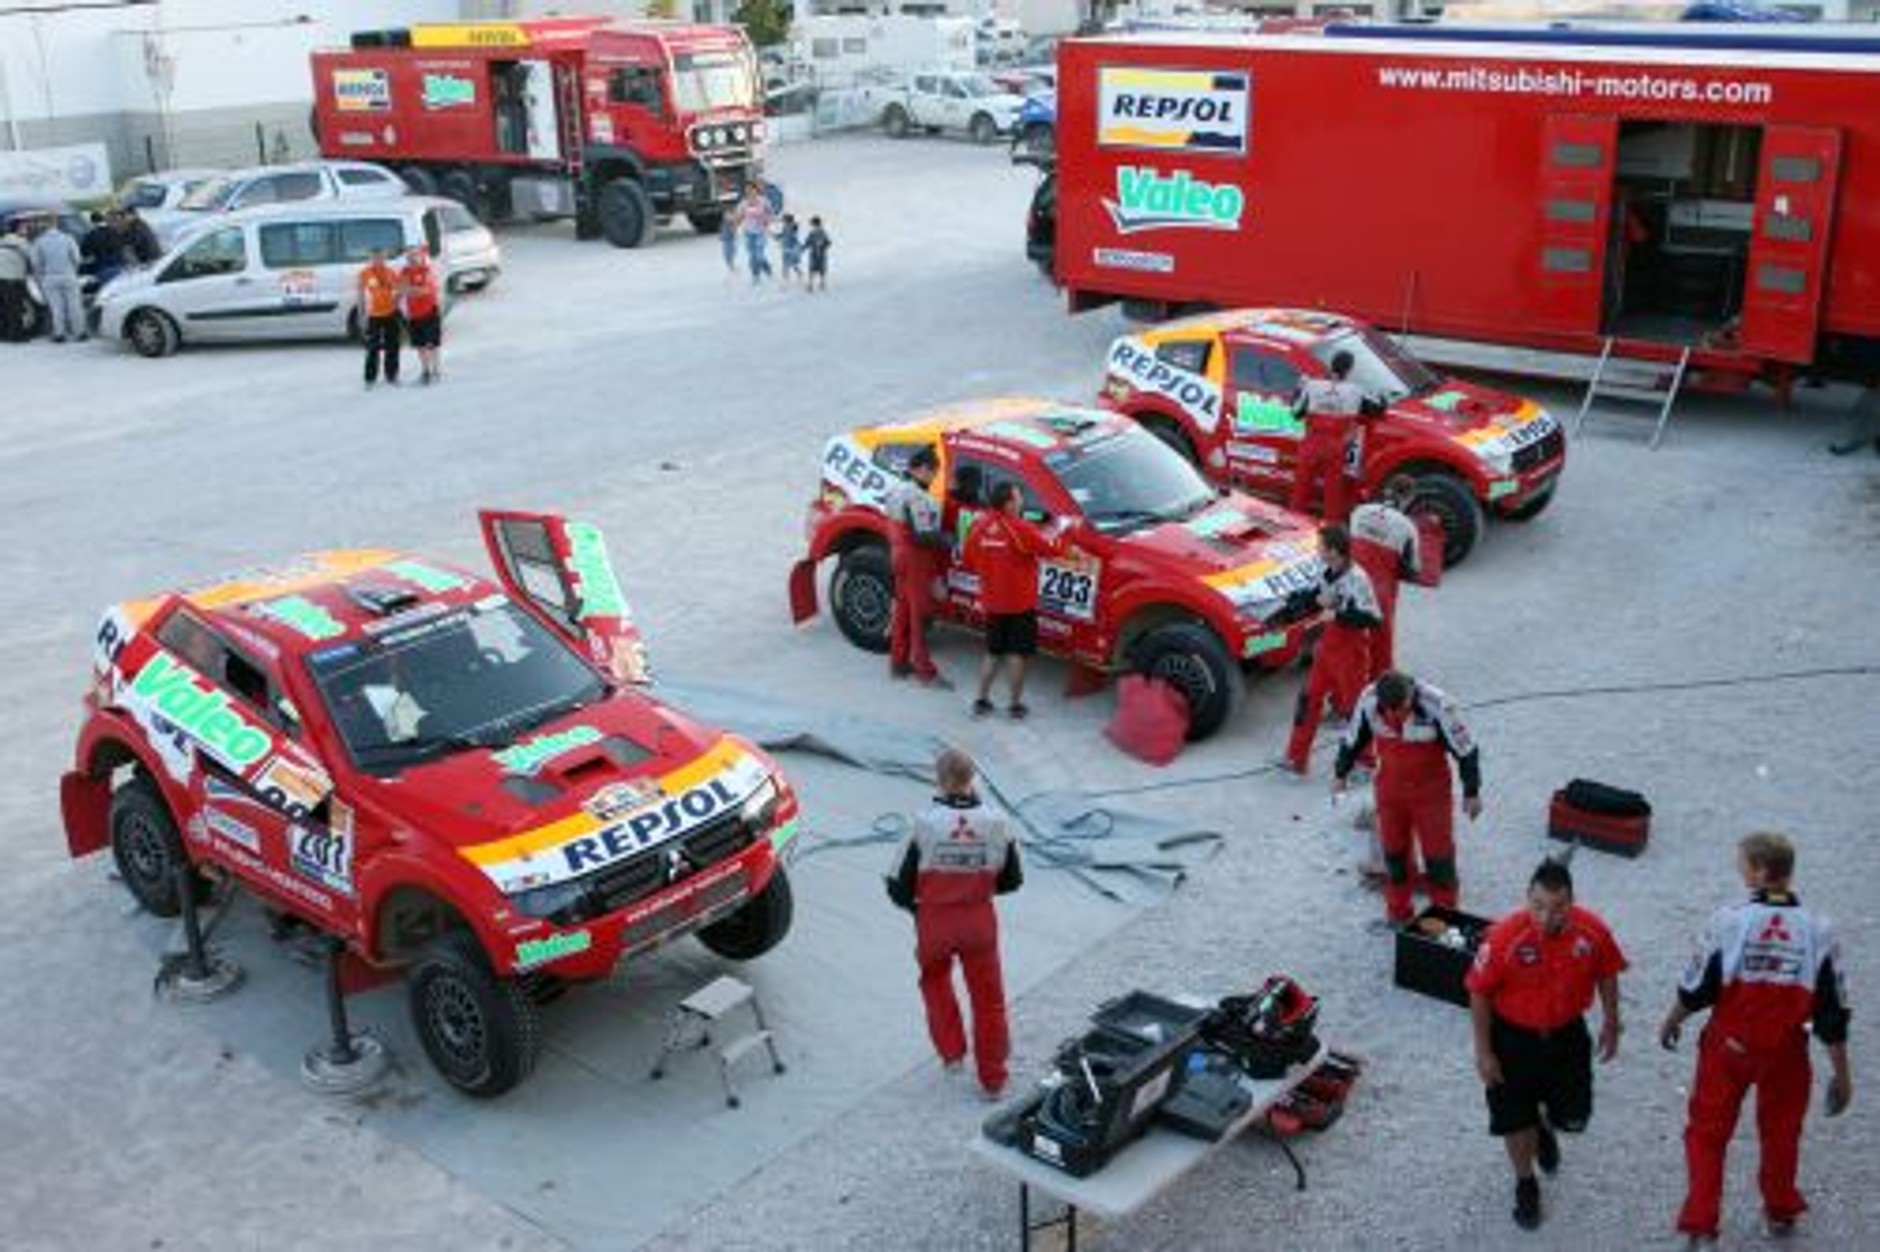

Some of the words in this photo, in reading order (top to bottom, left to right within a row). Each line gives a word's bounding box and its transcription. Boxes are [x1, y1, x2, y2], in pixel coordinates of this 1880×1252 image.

[1113, 94, 1233, 122] REPSOL
[1378, 66, 1772, 104] www.mitsubishi-motors.com
[1118, 167, 1244, 222] Valeo
[1111, 344, 1220, 416] REPSOL
[1042, 567, 1092, 604] 203
[132, 652, 271, 765] Valeo
[563, 778, 738, 871] REPSOL
